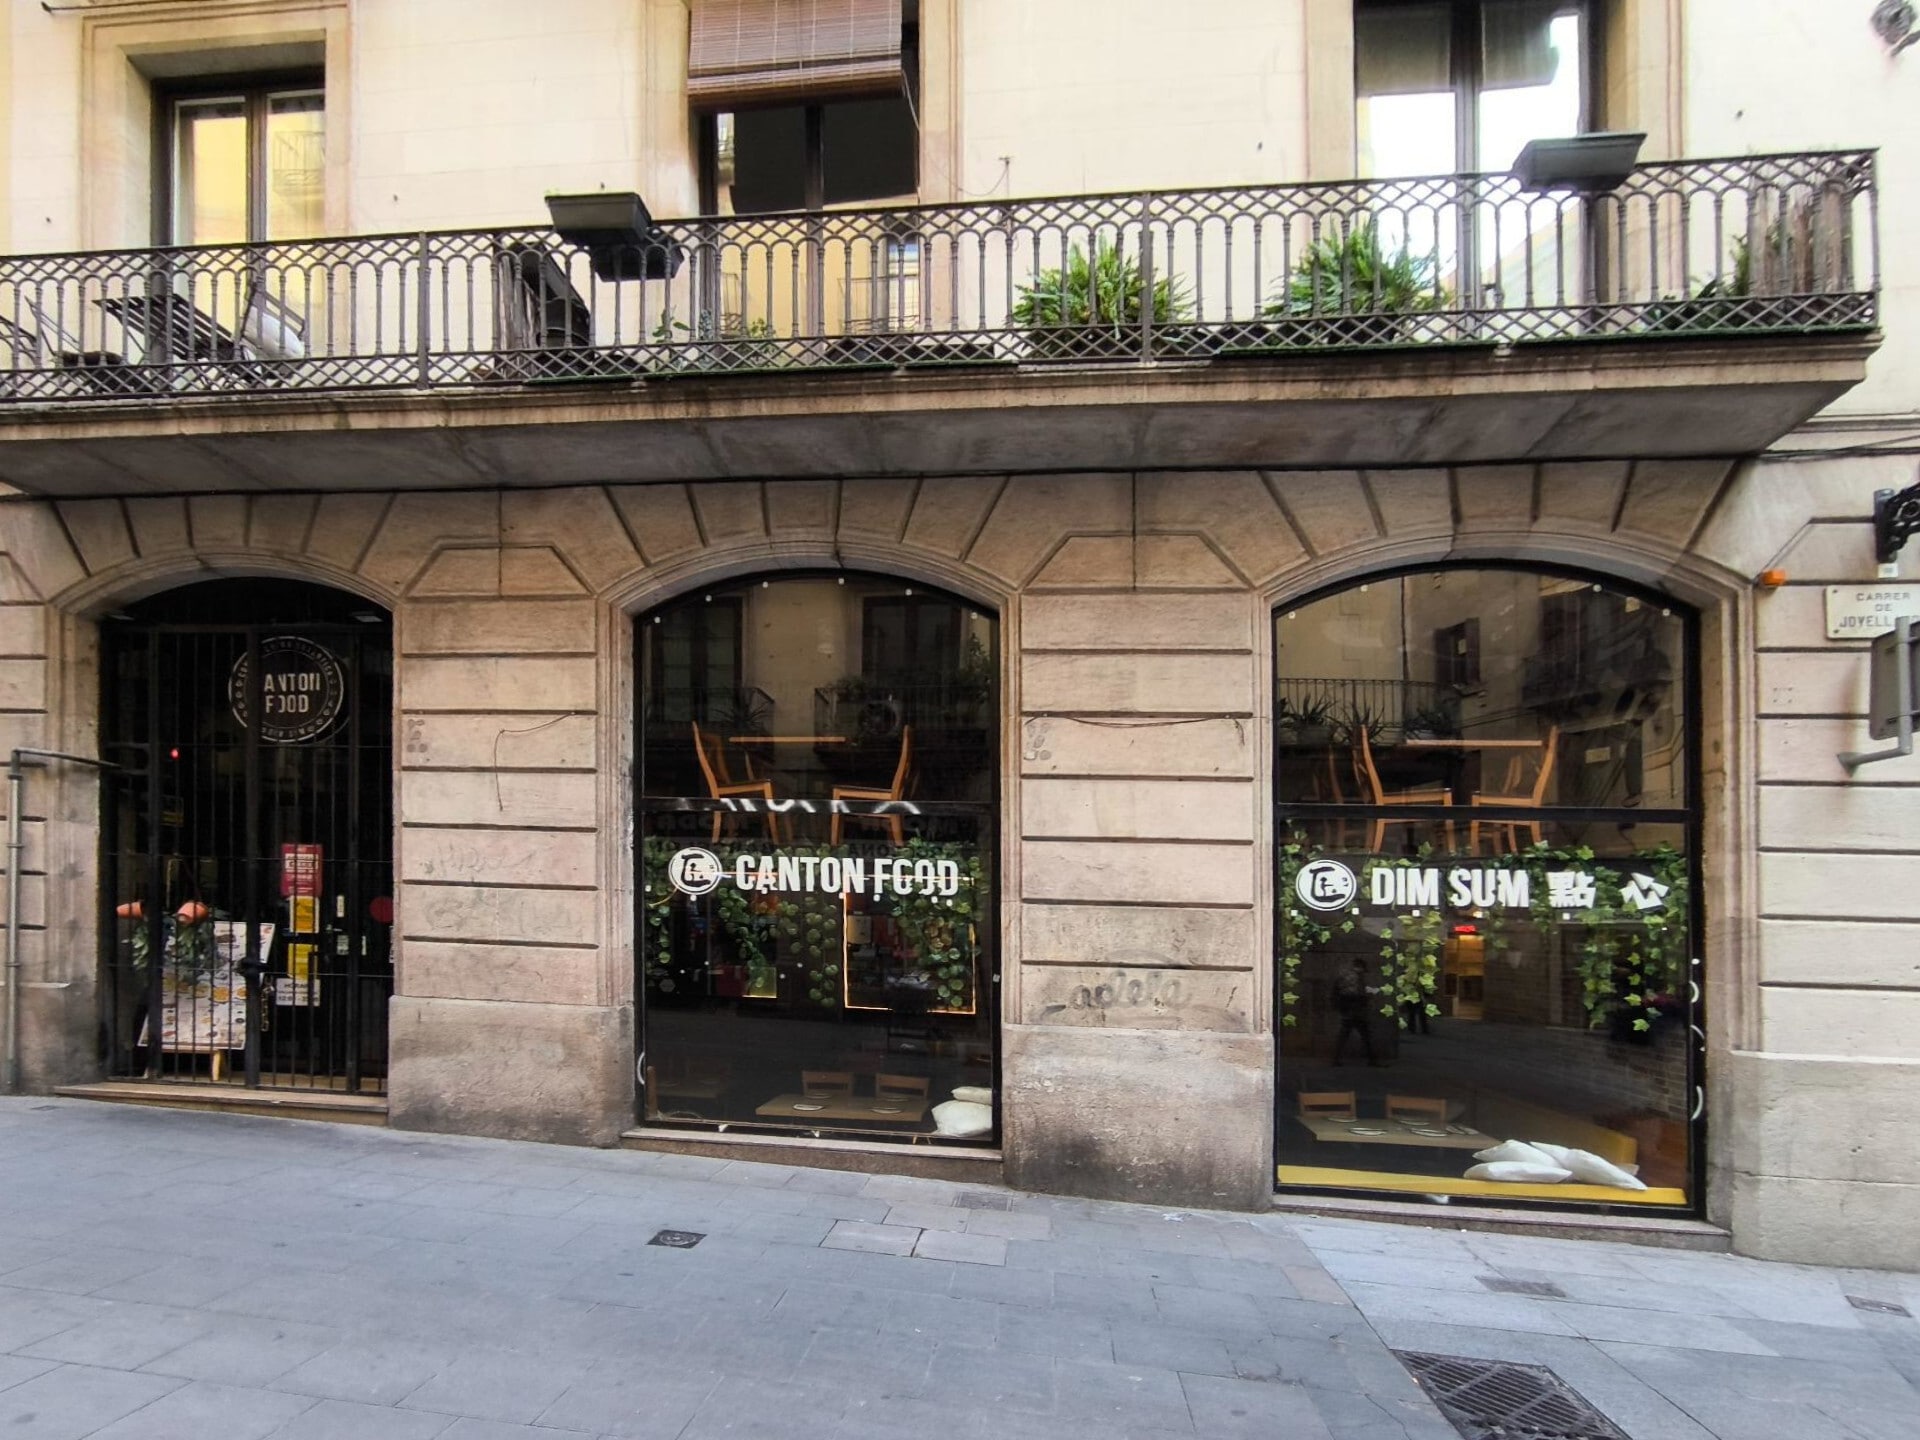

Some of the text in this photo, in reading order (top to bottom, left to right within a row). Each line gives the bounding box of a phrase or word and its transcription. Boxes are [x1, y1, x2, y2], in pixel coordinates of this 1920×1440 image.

[1856, 592, 1911, 601] CARRER
[1874, 603, 1893, 612] DE
[1839, 615, 1920, 628] JOVELL
[263, 673, 320, 692] ANTON
[735, 854, 959, 896] CANTON FOOD
[1371, 867, 1439, 906] DIM
[1448, 868, 1530, 907] SUM
